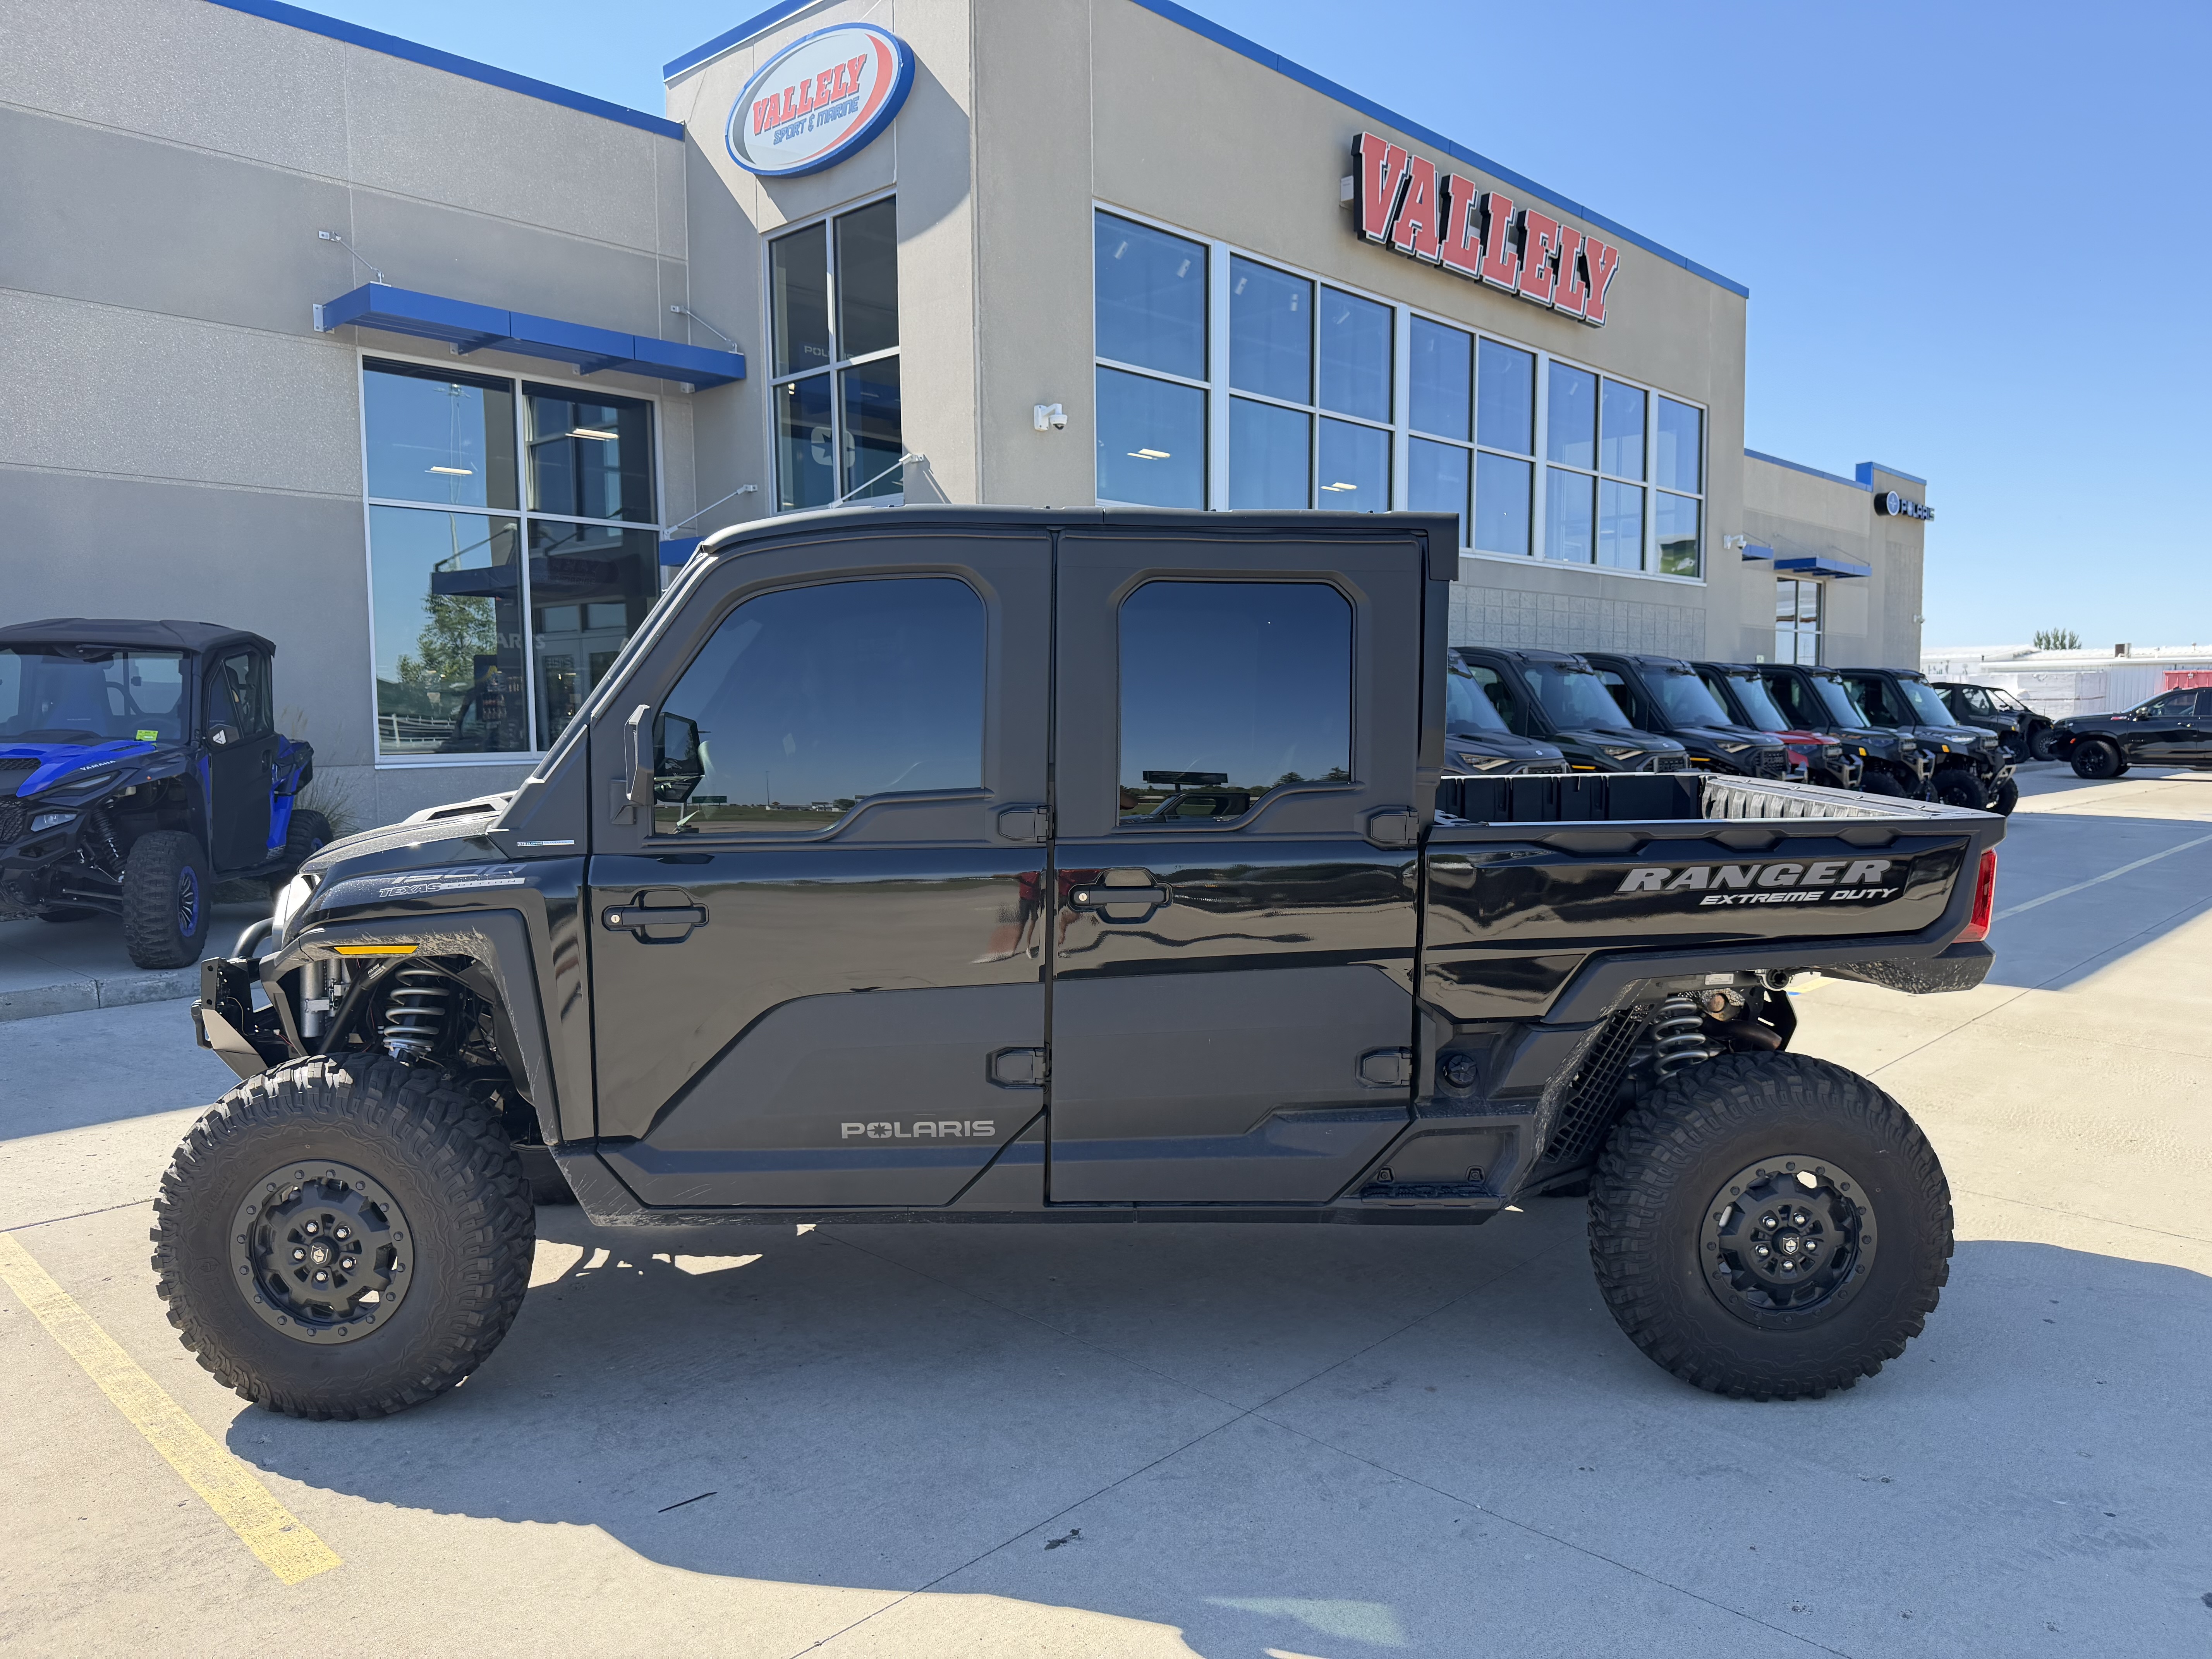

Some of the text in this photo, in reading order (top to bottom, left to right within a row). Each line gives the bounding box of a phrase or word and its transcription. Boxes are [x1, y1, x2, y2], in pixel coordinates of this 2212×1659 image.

[753, 53, 867, 136] VALLELY
[773, 96, 860, 145] SPORT & MARINE
[1352, 131, 1620, 328] VALLELY
[804, 345, 854, 361] POLIS
[1901, 498, 1935, 521] POLARIS
[497, 633, 546, 649] ARS
[80, 760, 116, 771] YAMAHA
[1616, 859, 1893, 892] RANGER
[379, 879, 515, 898] TEXAS EDITION
[1699, 887, 1899, 905] EXTREME DUTY
[841, 1120, 996, 1139] POLARIS
